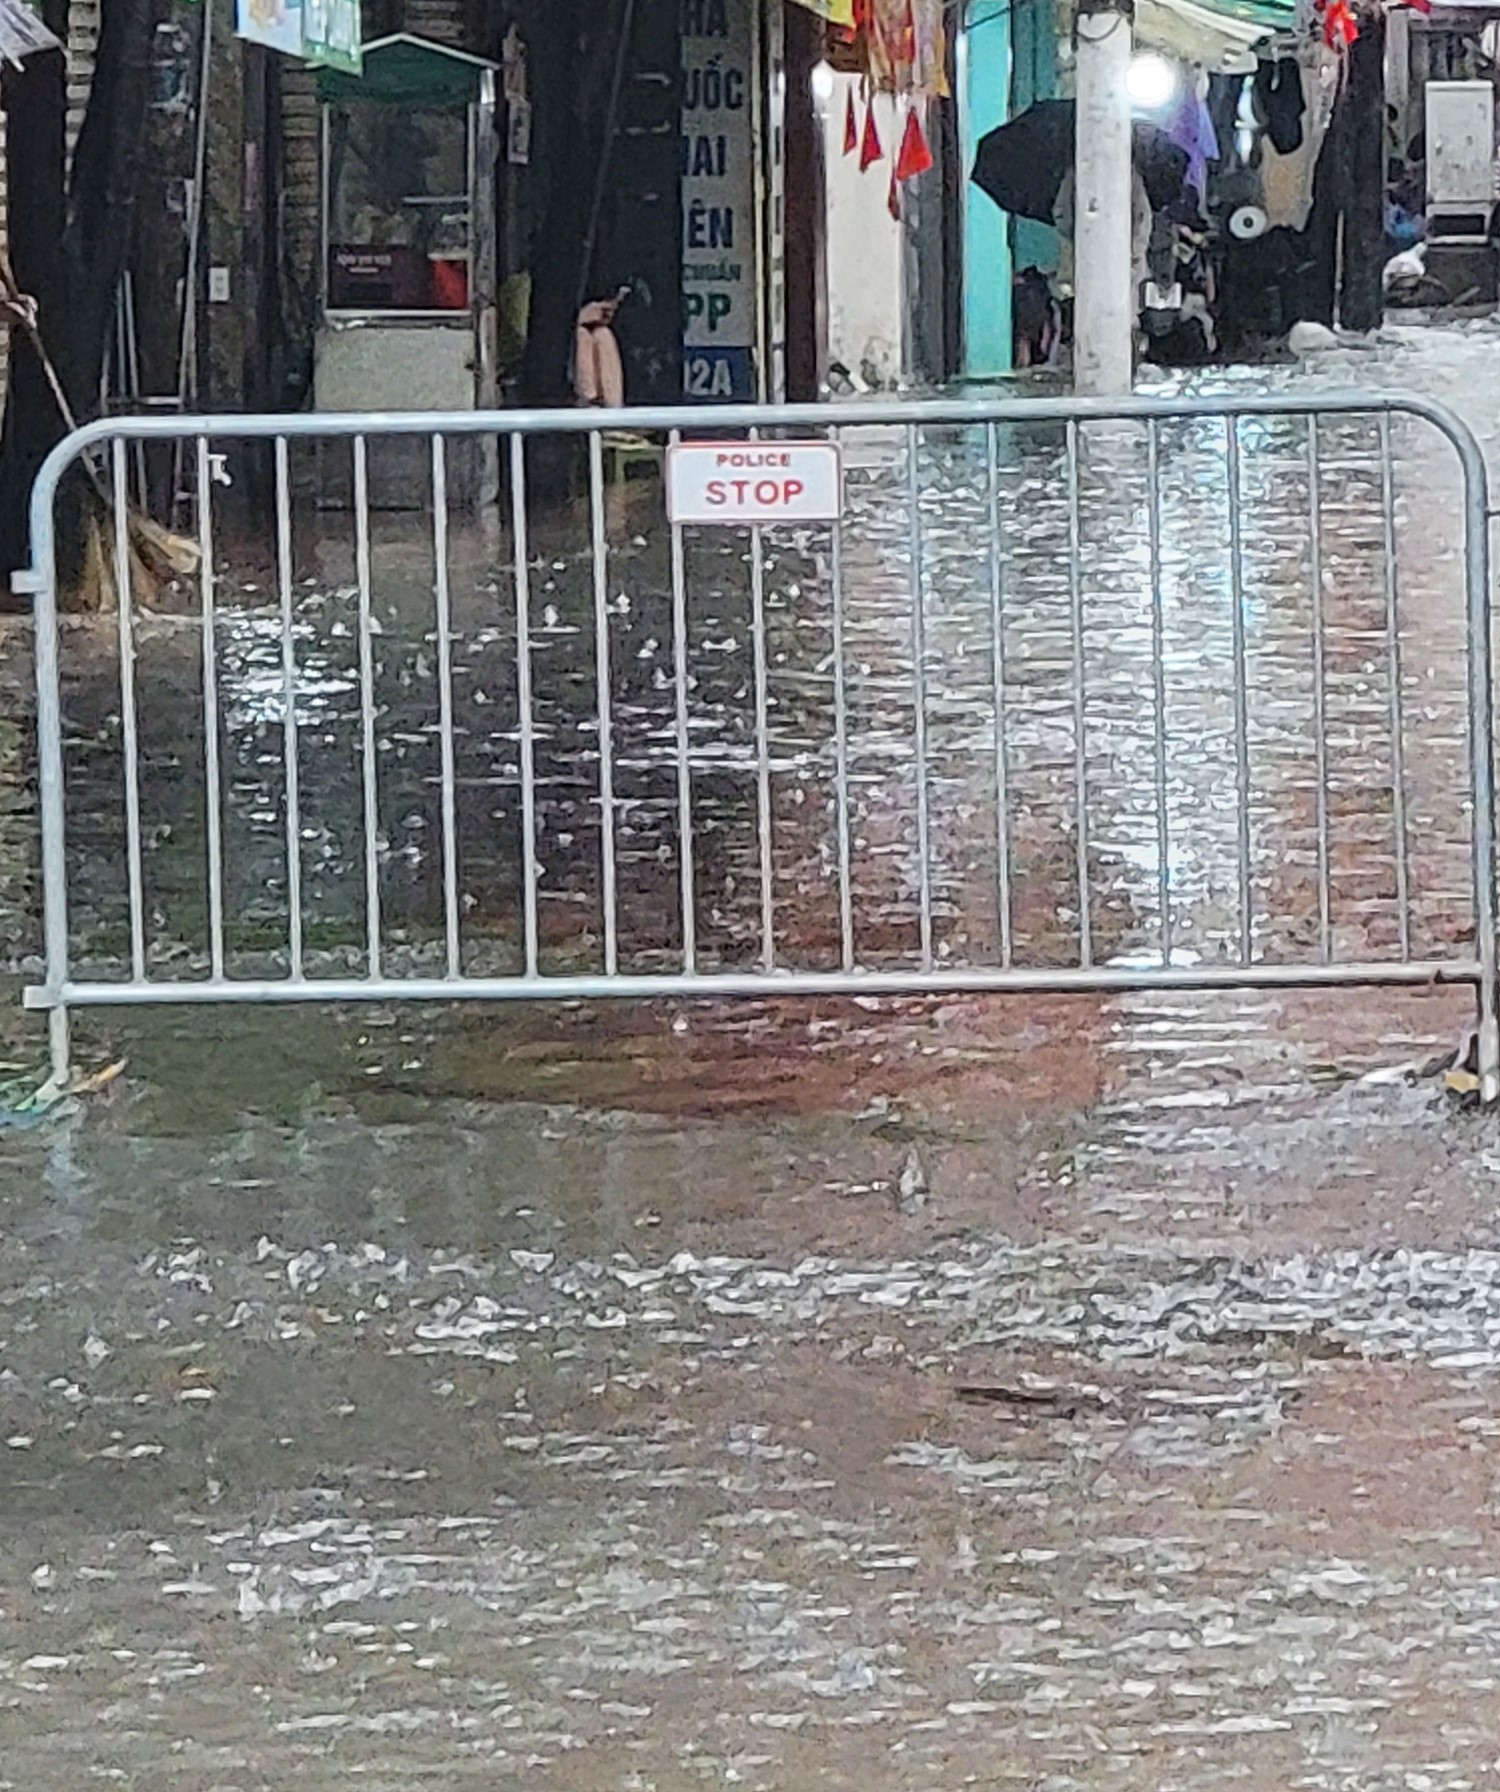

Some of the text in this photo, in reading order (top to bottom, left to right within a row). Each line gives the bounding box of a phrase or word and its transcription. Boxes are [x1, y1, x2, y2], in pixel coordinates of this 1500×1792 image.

[684, 53, 743, 110] UỐC
[683, 293, 731, 332] PP
[717, 453, 791, 467] POLICE
[705, 479, 803, 505] STOP
